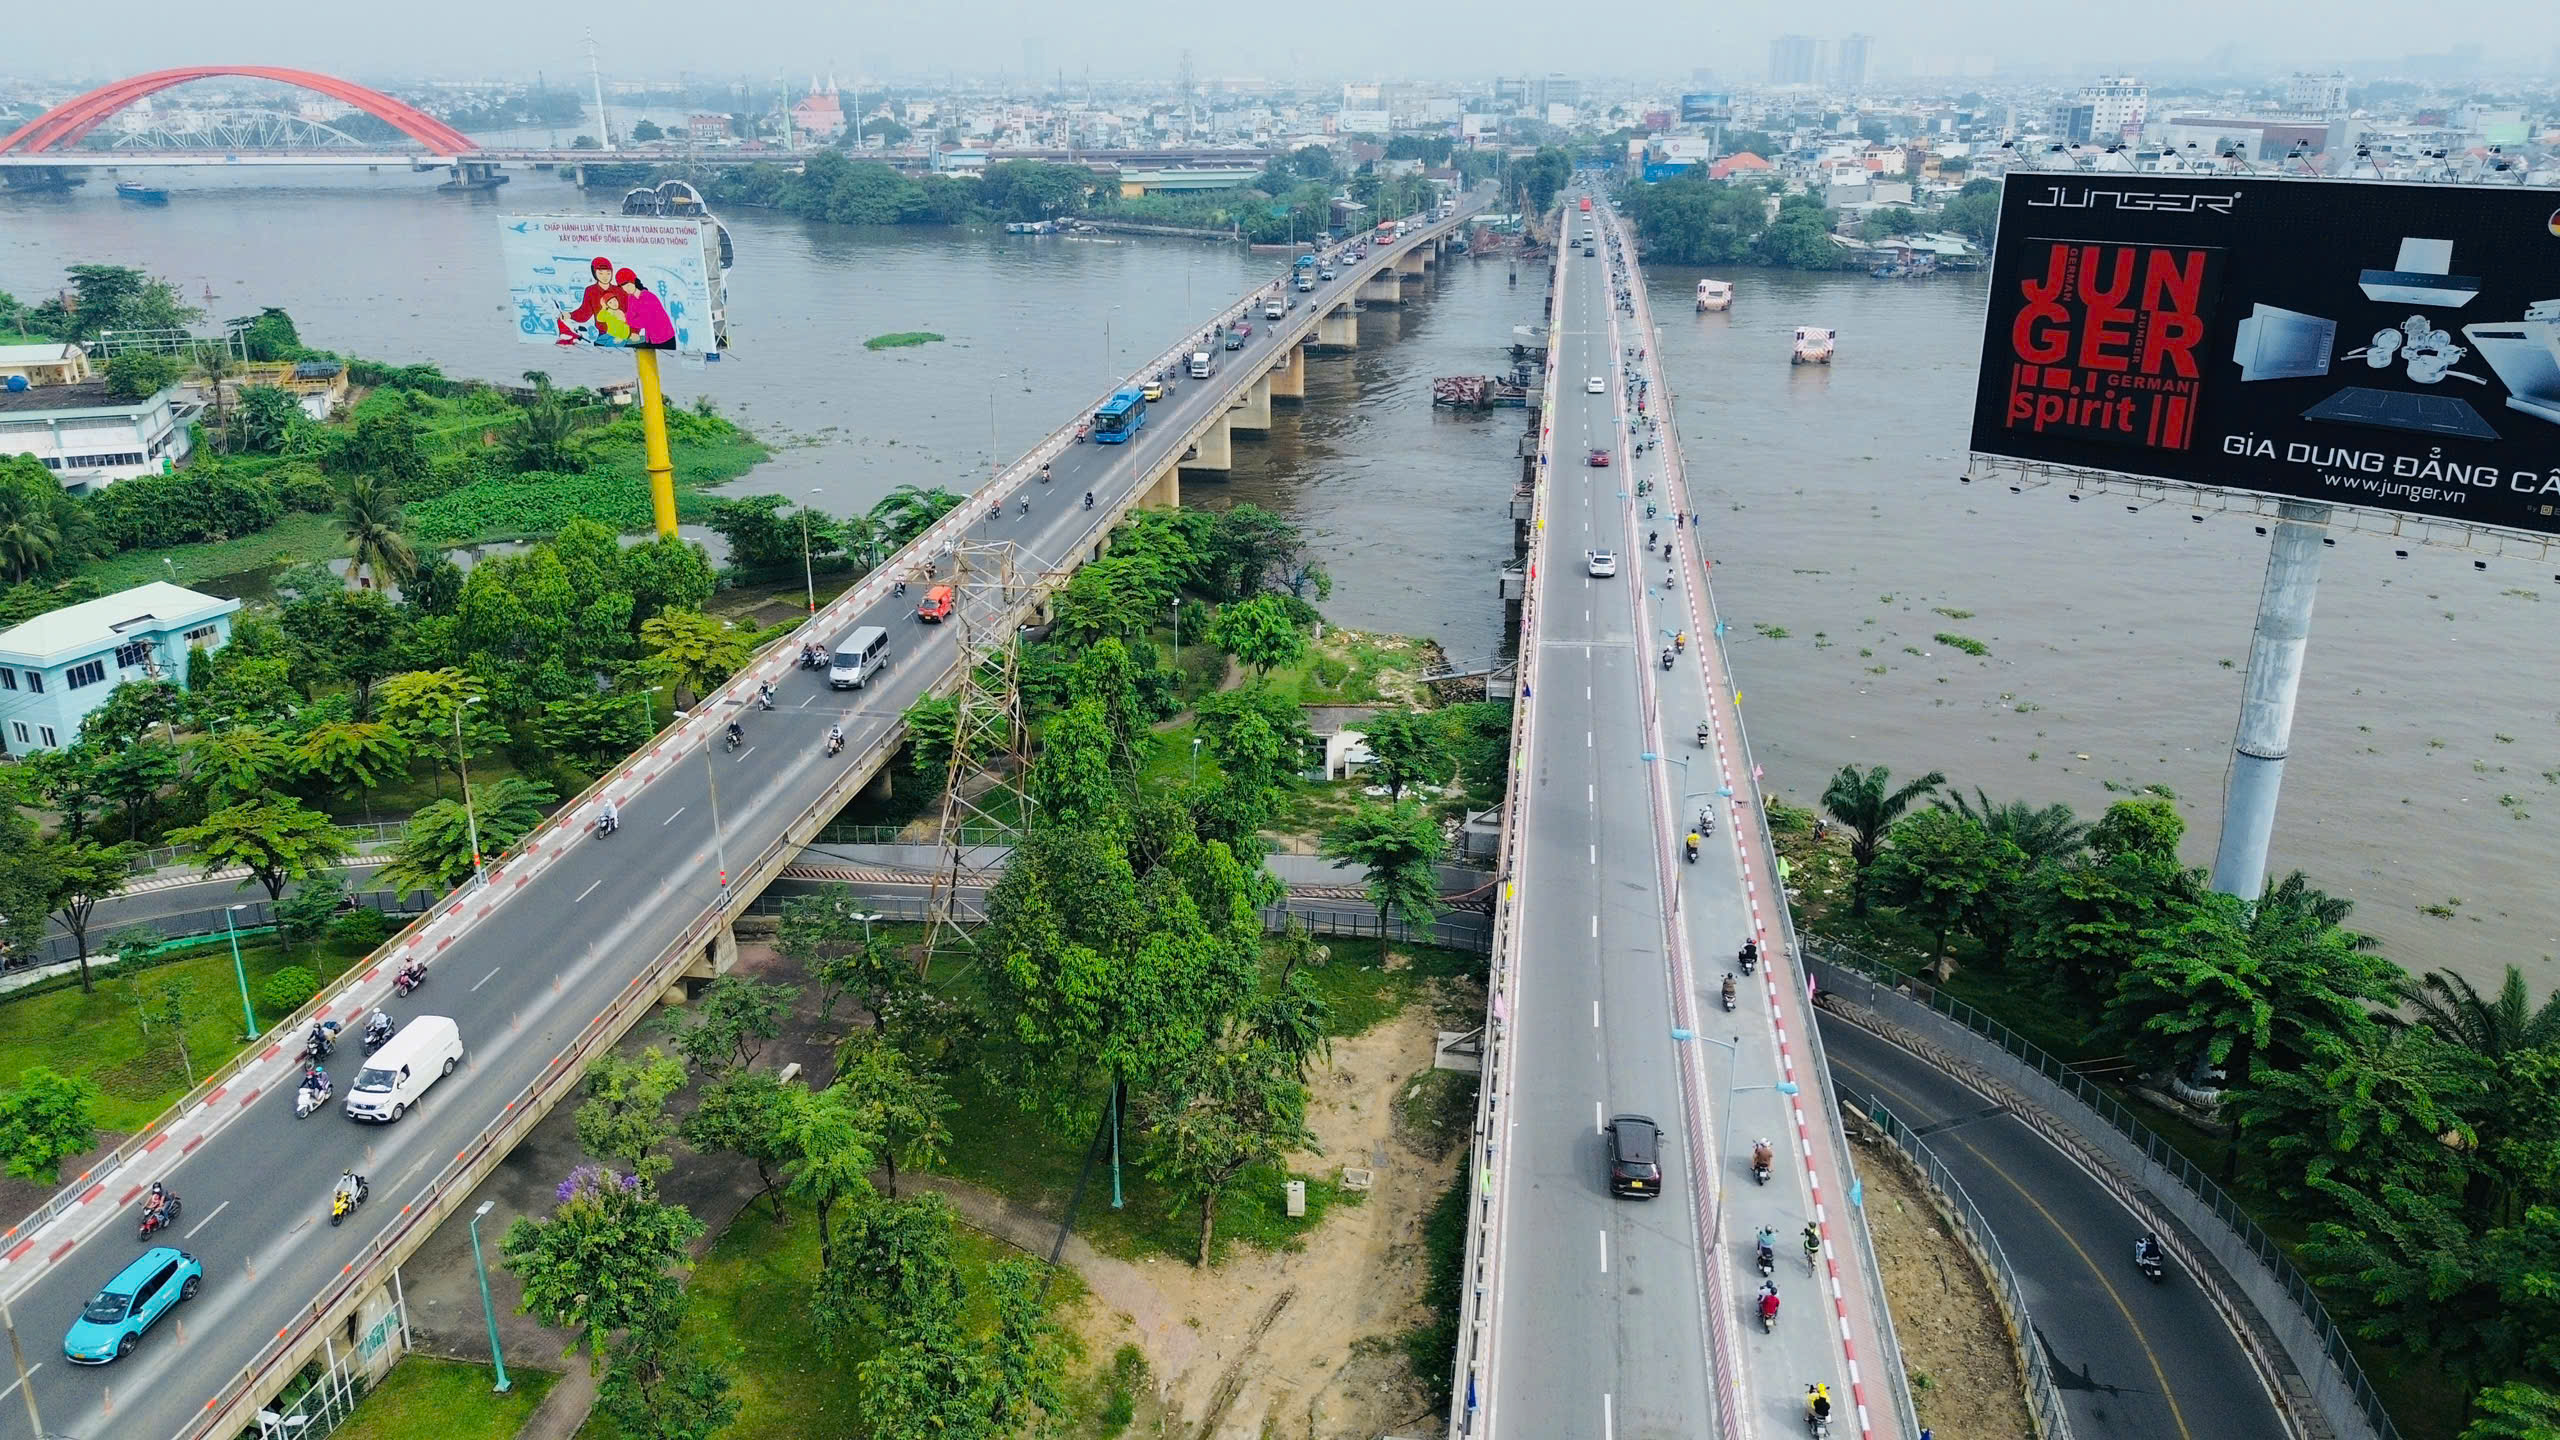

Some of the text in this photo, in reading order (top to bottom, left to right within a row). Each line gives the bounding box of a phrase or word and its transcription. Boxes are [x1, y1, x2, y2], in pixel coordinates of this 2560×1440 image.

[562, 222, 579, 232] HÀNH
[641, 225, 658, 234] TOÀN
[659, 226, 674, 234] GIAO
[675, 226, 697, 235] THÔNG
[649, 237, 665, 245] GIAO
[666, 236, 688, 246] THÔNG
[2021, 244, 2206, 314] JUN
[2063, 248, 2079, 302] GERMAN
[2012, 302, 2204, 379] GER
[2131, 312, 2147, 364] JUNGER
[2107, 374, 2190, 394] GERMAN
[2012, 386, 2136, 432] spirit
[2287, 443, 2385, 473] DỤNG
[2393, 447, 2499, 488] ĐẲNG
[2324, 474, 2466, 503] www.junger.vn
